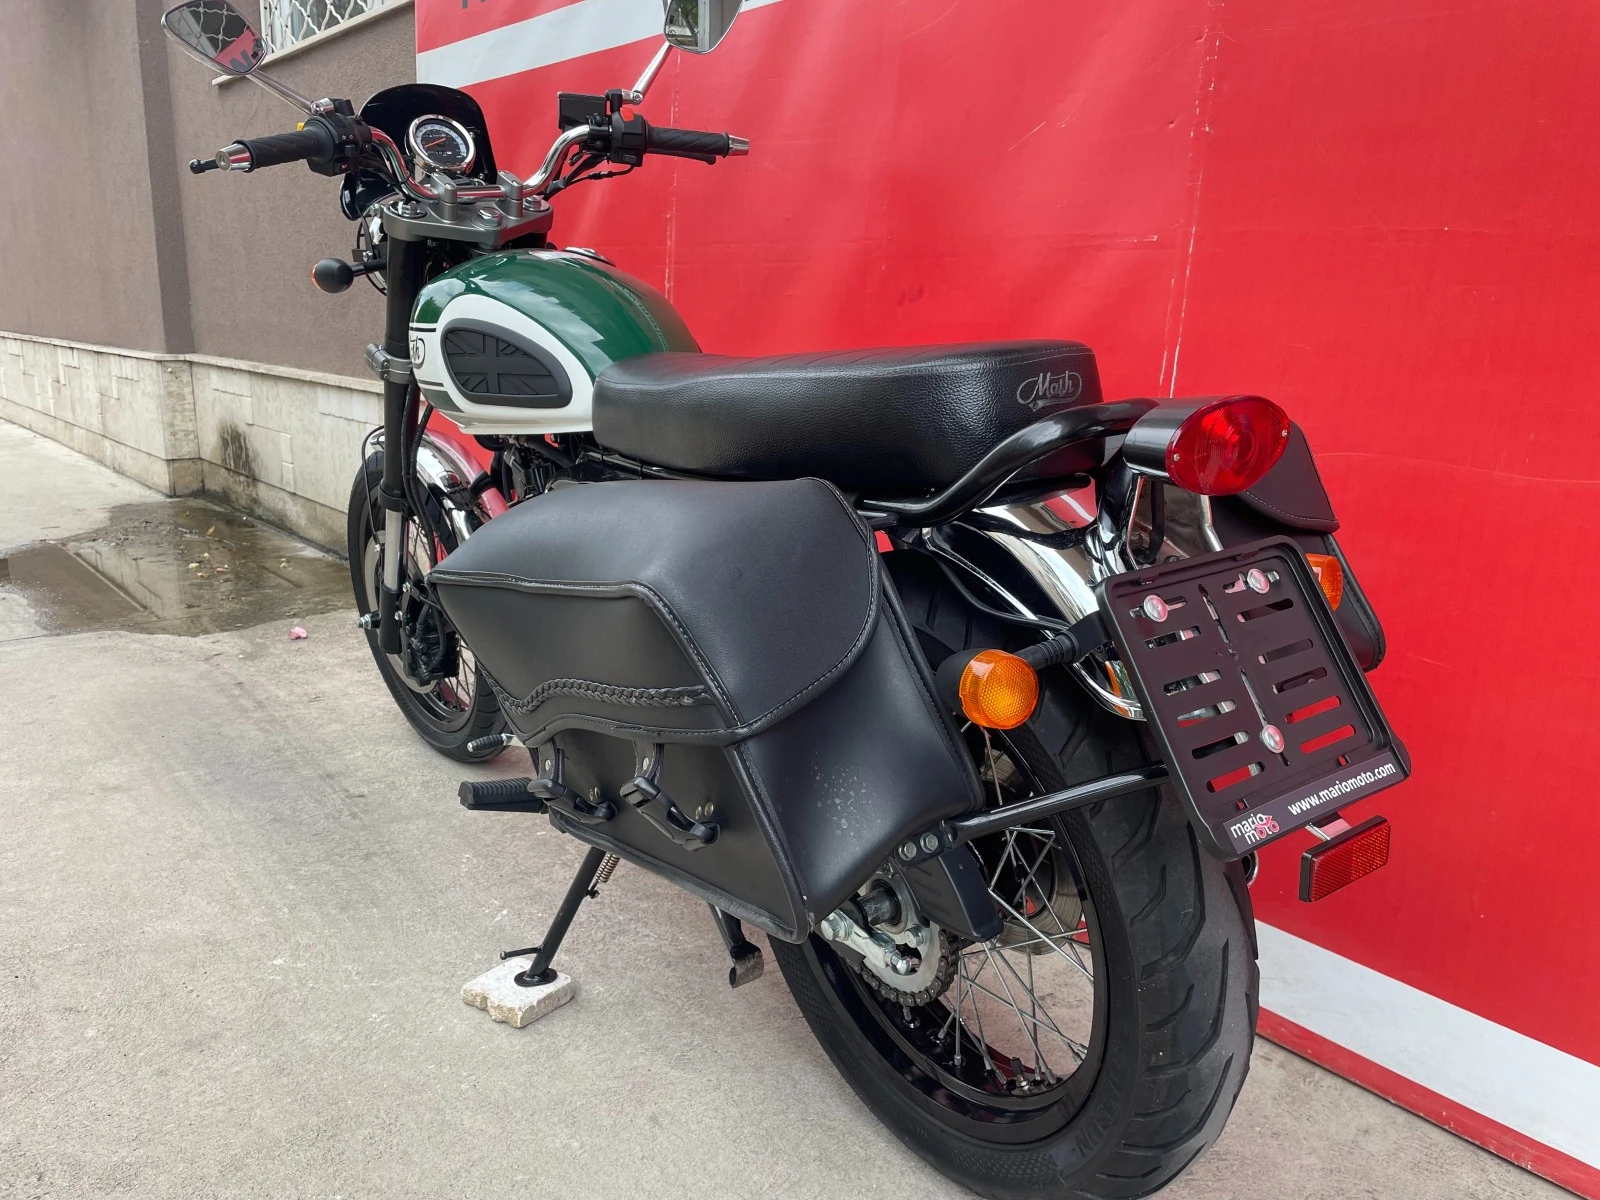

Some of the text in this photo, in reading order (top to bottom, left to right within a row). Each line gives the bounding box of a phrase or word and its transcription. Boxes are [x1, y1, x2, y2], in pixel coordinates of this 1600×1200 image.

[1017, 370, 1075, 404] Mash
[1287, 762, 1396, 816] www.mariomoto.com
[1230, 813, 1267, 838] mario
[1245, 820, 1280, 845] moto
